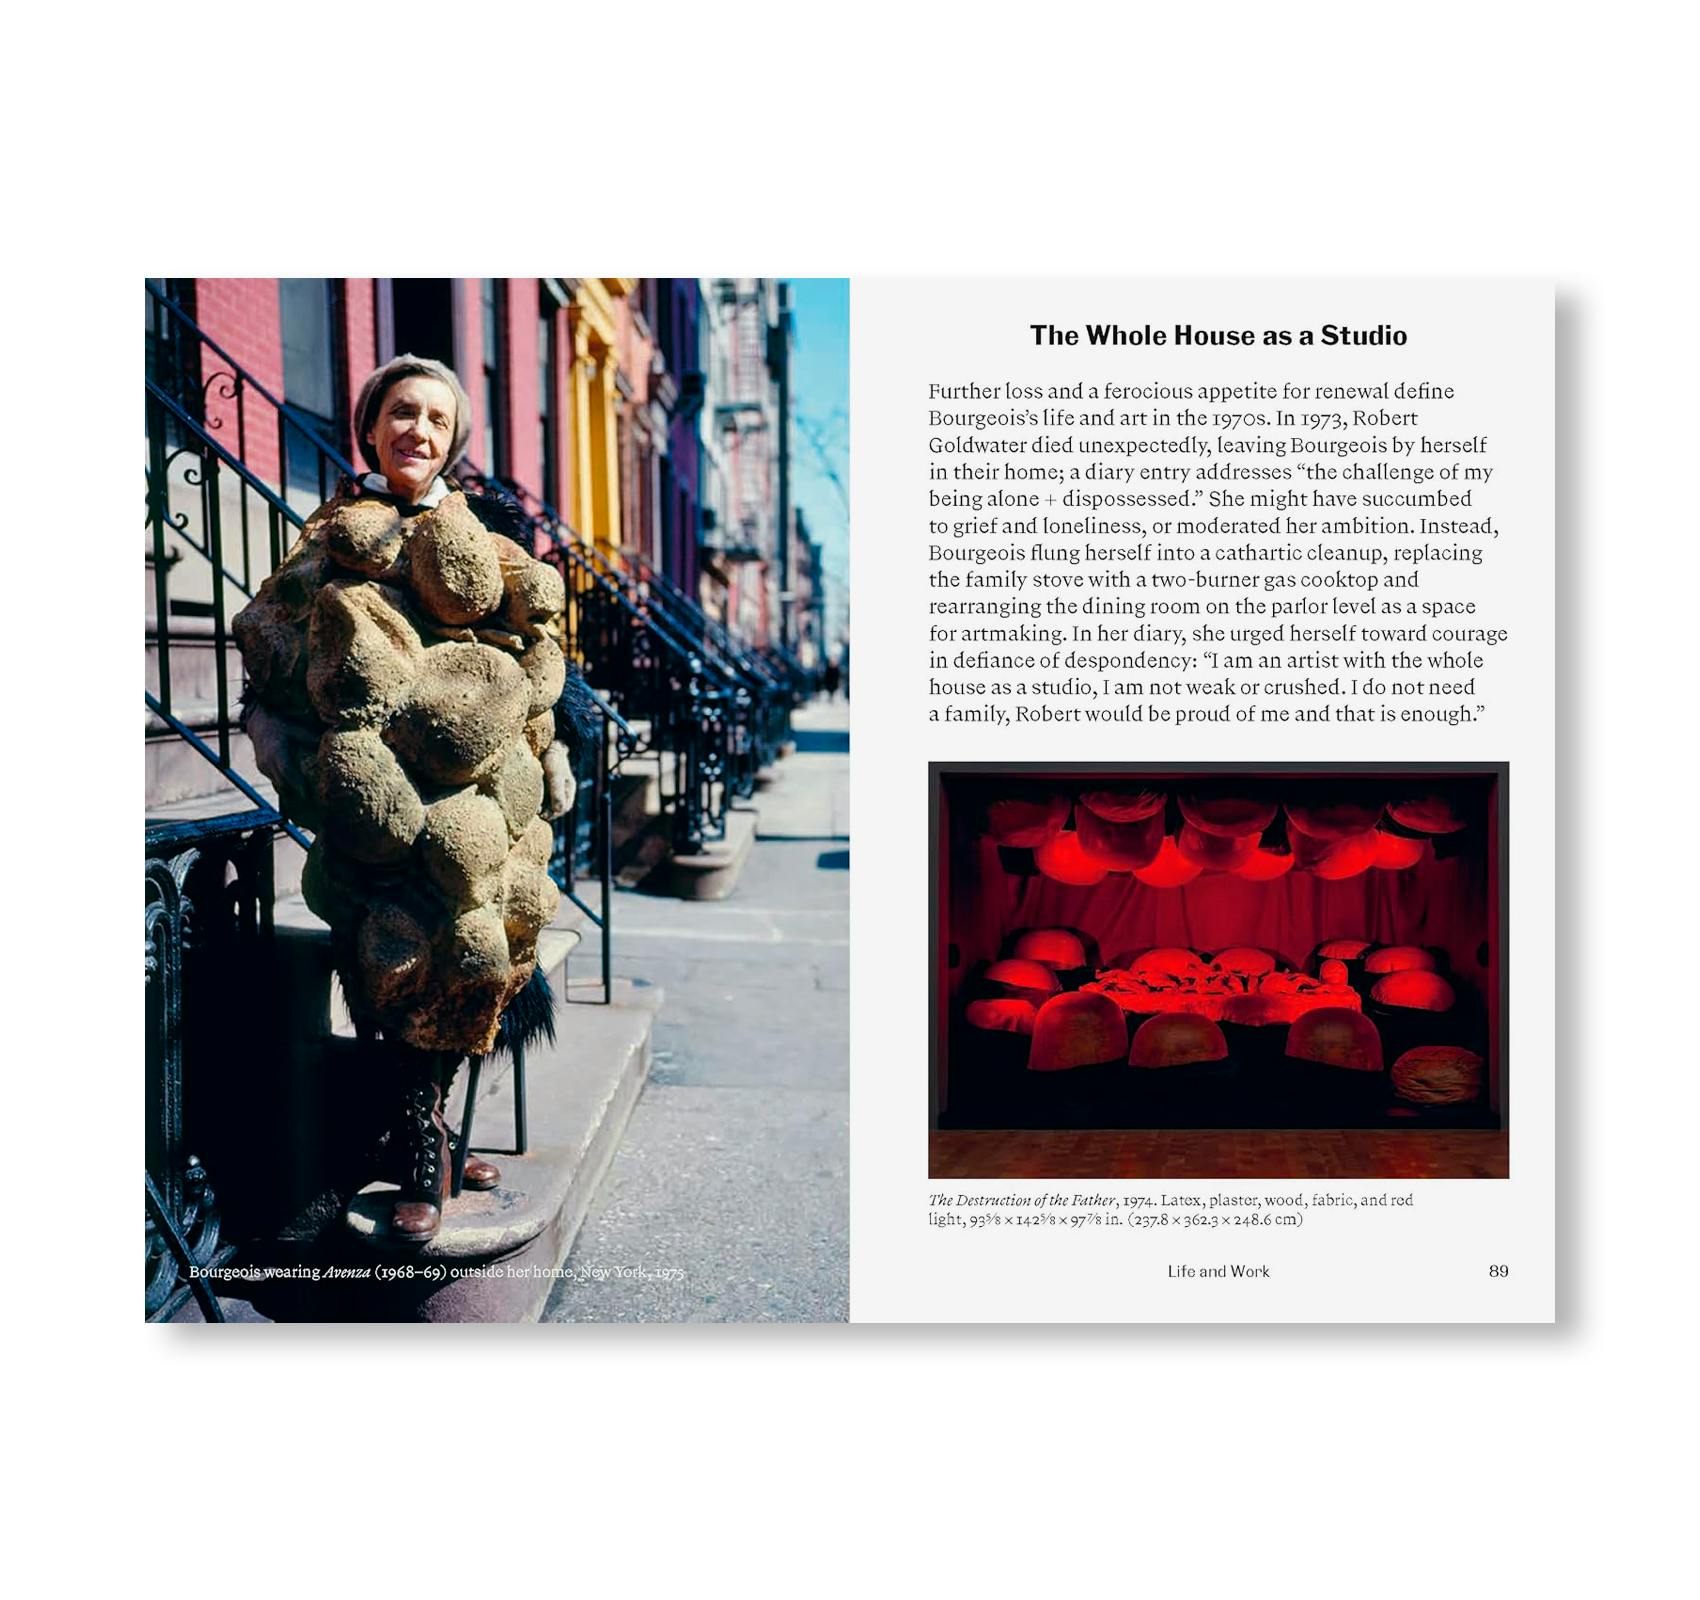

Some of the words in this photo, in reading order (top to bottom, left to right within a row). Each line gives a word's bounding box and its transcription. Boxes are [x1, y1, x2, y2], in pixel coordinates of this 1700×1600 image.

[1029, 324, 1080, 346] The
[1084, 324, 1167, 347] Whole
[1174, 324, 1256, 346] House
[1262, 329, 1293, 346] as
[1298, 329, 1315, 346] a
[1320, 323, 1408, 347] Studio
[928, 381, 1002, 400] Further
[1005, 381, 1044, 400] loss
[1047, 381, 1084, 400] and
[1088, 386, 1100, 400] a
[1103, 381, 1194, 400] ferocious
[1197, 381, 1278, 404] appetite
[1282, 381, 1311, 400] for
[1314, 381, 1390, 400] renewal
[1393, 381, 1455, 400] define
[1042, 407, 1075, 426] life
[1079, 408, 1115, 426] and
[1119, 412, 1148, 427] art
[1152, 407, 1171, 426] in
[1176, 408, 1208, 426] the
[1212, 412, 1271, 431] 1970s.
[1275, 410, 1296, 426] In
[1300, 412, 1349, 431] 1973,
[1352, 408, 1419, 426] Robert
[929, 461, 948, 481] in
[952, 462, 1000, 481] their
[1004, 462, 1065, 485] home;
[1069, 467, 1081, 480] a
[1085, 461, 1136, 484] diary
[1139, 466, 1191, 484] entry
[1195, 462, 1293, 481] addresses
[1342, 462, 1435, 485] challenge
[1439, 462, 1460, 481] of
[1464, 467, 1494, 484] my
[928, 488, 984, 512] being
[987, 489, 1040, 507] alone
[1062, 488, 1204, 511] dispossessed.”
[1208, 488, 1245, 508] She
[1249, 488, 1309, 512] might
[1312, 489, 1358, 507] have
[1362, 488, 1473, 507] succumbed
[928, 542, 1026, 566] Bourgeois
[1030, 543, 1081, 566] flung
[1084, 543, 1153, 561] herself
[1156, 542, 1196, 561] into
[1200, 548, 1211, 561] a
[1215, 542, 1303, 561] cathartic
[1306, 543, 1389, 566] cleanup,
[1393, 542, 1484, 565] replacing
[928, 569, 961, 588] the
[965, 569, 1028, 592] family
[1032, 573, 1084, 588] stove
[1087, 569, 1131, 588] with
[1136, 575, 1148, 588] a
[1151, 570, 1261, 588] two-burner
[1263, 574, 1297, 592] gas
[1300, 569, 1379, 592] cooktop
[1383, 570, 1420, 588] and
[929, 596, 1042, 619] rearranging
[1045, 596, 1078, 615] the
[1082, 596, 1146, 619] dining
[1150, 601, 1201, 615] room
[1205, 601, 1230, 615] on
[1234, 596, 1267, 615] the
[1271, 596, 1329, 619] parlor
[1332, 596, 1377, 615] level
[1381, 601, 1402, 615] as
[1406, 601, 1418, 615] a
[1421, 601, 1476, 619] space
[929, 624, 958, 642] for
[961, 623, 1068, 646] artmaking.
[1072, 625, 1092, 642] In
[1097, 623, 1129, 642] her
[1133, 623, 1187, 647] diary,
[1192, 623, 1226, 642] she
[1230, 623, 1285, 646] urged
[1289, 623, 1358, 642] herself
[1360, 623, 1428, 642] toward
[1432, 628, 1508, 646] courage
[929, 650, 949, 669] in
[953, 650, 1036, 669] defiance
[1039, 650, 1061, 669] of
[1064, 650, 1198, 673] despondency:
[1223, 655, 1254, 669] am
[1258, 655, 1283, 669] an
[1287, 650, 1340, 669] artist
[1342, 650, 1387, 669] with
[1391, 650, 1423, 669] the
[1426, 650, 1484, 669] whole
[928, 677, 986, 696] house
[990, 682, 1012, 695] as
[1016, 682, 1028, 695] a
[1031, 677, 1098, 701] studio,
[1102, 679, 1110, 696] I
[1114, 682, 1144, 696] am
[1149, 681, 1183, 696] not
[1185, 677, 1237, 696] weak
[1240, 682, 1261, 696] or
[1263, 677, 1347, 696] crushed.
[1351, 679, 1358, 696] I
[1362, 677, 1387, 696] do
[1391, 681, 1425, 696] not
[1428, 677, 1476, 696] need
[928, 709, 940, 722] a
[944, 703, 1011, 727] family,
[1015, 703, 1082, 723] Robert
[1084, 704, 1144, 723] would
[1148, 704, 1171, 723] be
[1174, 704, 1231, 726] proud
[1235, 704, 1257, 722] of
[1260, 709, 1290, 723] me
[1294, 704, 1331, 722] and
[1335, 704, 1376, 723] that
[1380, 703, 1397, 723] is
[1400, 704, 1486, 727] enough.”
[929, 1192, 954, 1207] The
[955, 1193, 1032, 1207] Destruction
[1033, 1192, 1050, 1209] of
[1050, 1192, 1069, 1207] the
[1071, 1193, 1120, 1210] Father,
[1122, 1196, 1158, 1209] 1974.
[1160, 1194, 1207, 1210] Latex,
[1209, 1192, 1262, 1210] plaster,
[1264, 1192, 1309, 1210] wood,
[1311, 1192, 1358, 1210] fabric,
[1360, 1192, 1388, 1207] and
[1390, 1192, 1414, 1207] red
[928, 1211, 967, 1229] light,
[1105, 1211, 1124, 1226] in.
[1127, 1211, 1169, 1229] (237.8
[1183, 1213, 1219, 1229] 362.3
[1233, 1212, 1272, 1228] 248.6
[1274, 1211, 1304, 1228] cm)
[189, 1264, 261, 1281] Bourgeois
[263, 1264, 321, 1281] wearing
[321, 1265, 371, 1279] Avenza
[450, 1264, 504, 1279] outside
[507, 1264, 529, 1279] her
[533, 1264, 577, 1281] home,
[581, 1265, 611, 1279] New
[615, 1265, 651, 1281] York,
[656, 1266, 685, 1281] 1975
[1168, 1264, 1196, 1278] Life
[1199, 1264, 1227, 1278] and
[1230, 1264, 1271, 1278] Work
[1488, 1264, 1509, 1278] 89
